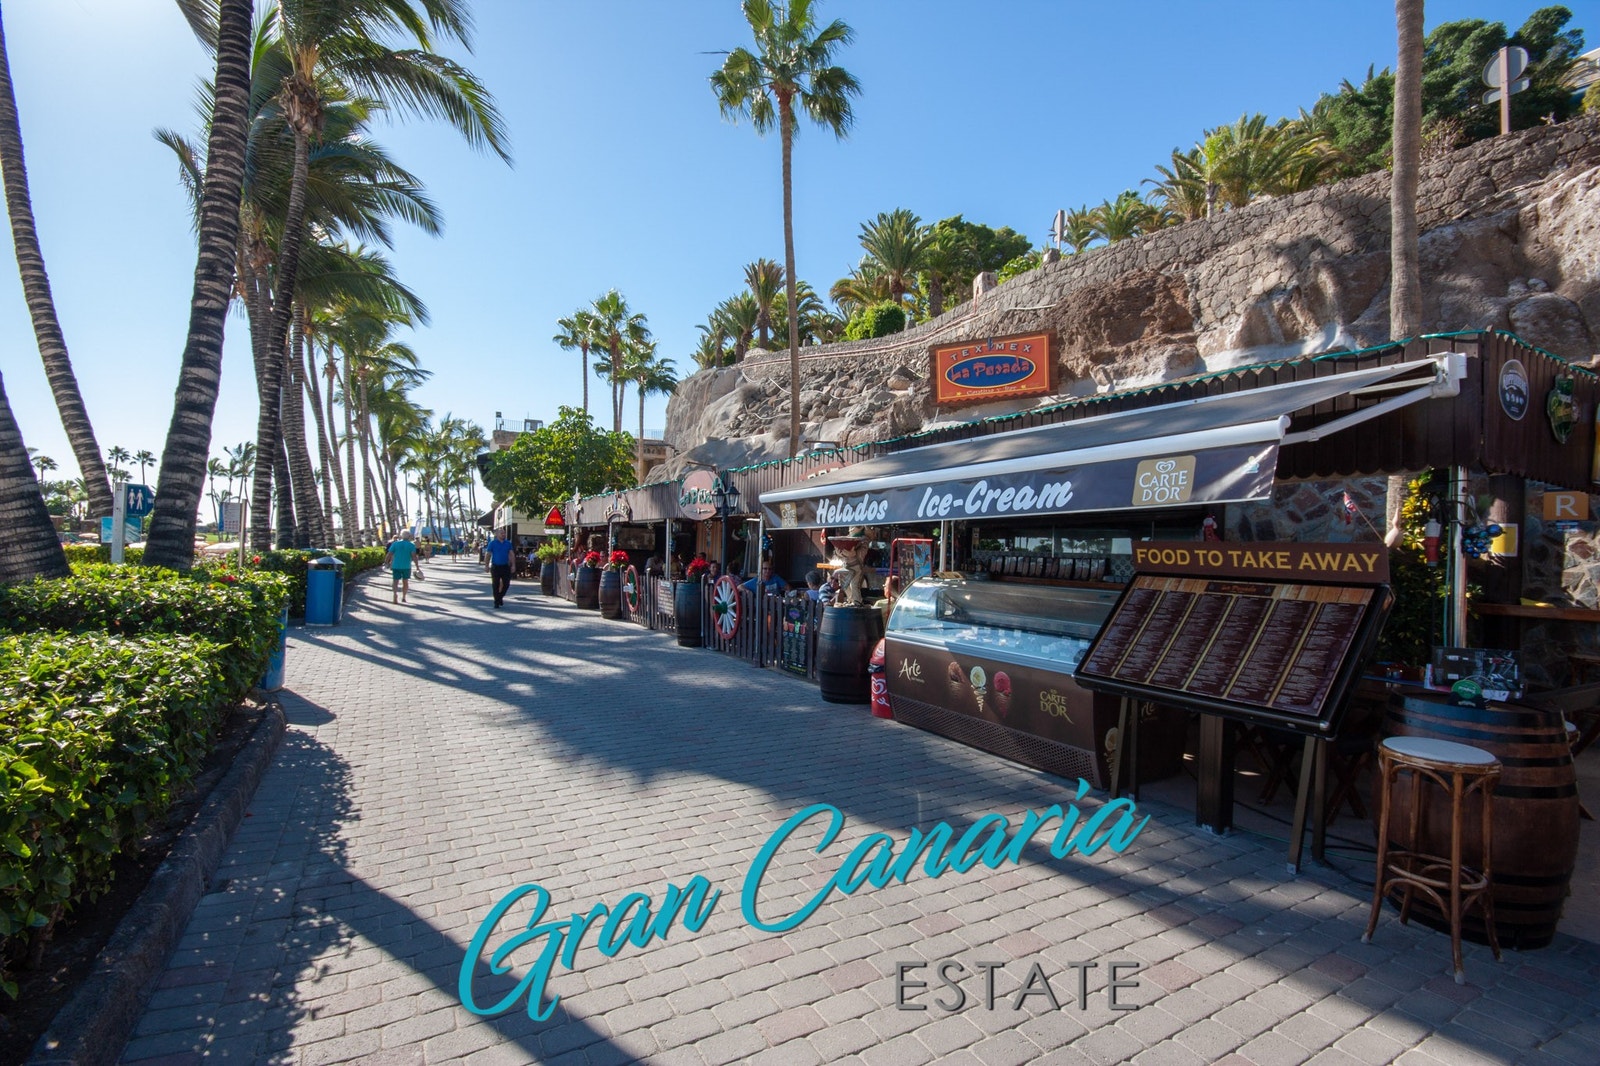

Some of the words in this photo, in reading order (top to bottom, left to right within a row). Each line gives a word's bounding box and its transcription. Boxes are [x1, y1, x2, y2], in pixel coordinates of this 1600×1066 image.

[950, 345, 983, 361] TEX
[995, 343, 1032, 353] MEX
[950, 367, 970, 382] La
[1139, 470, 1188, 489] CARTE
[816, 493, 889, 524] Helados
[917, 480, 1074, 518] Ice-Cream
[1141, 486, 1182, 502] D'OR
[1136, 548, 1191, 566] FOOD
[1195, 549, 1223, 567] TO
[1228, 550, 1292, 570] TAKE
[1298, 552, 1380, 572] AWAY
[898, 658, 921, 680] Arte
[1039, 691, 1067, 704] CARTE
